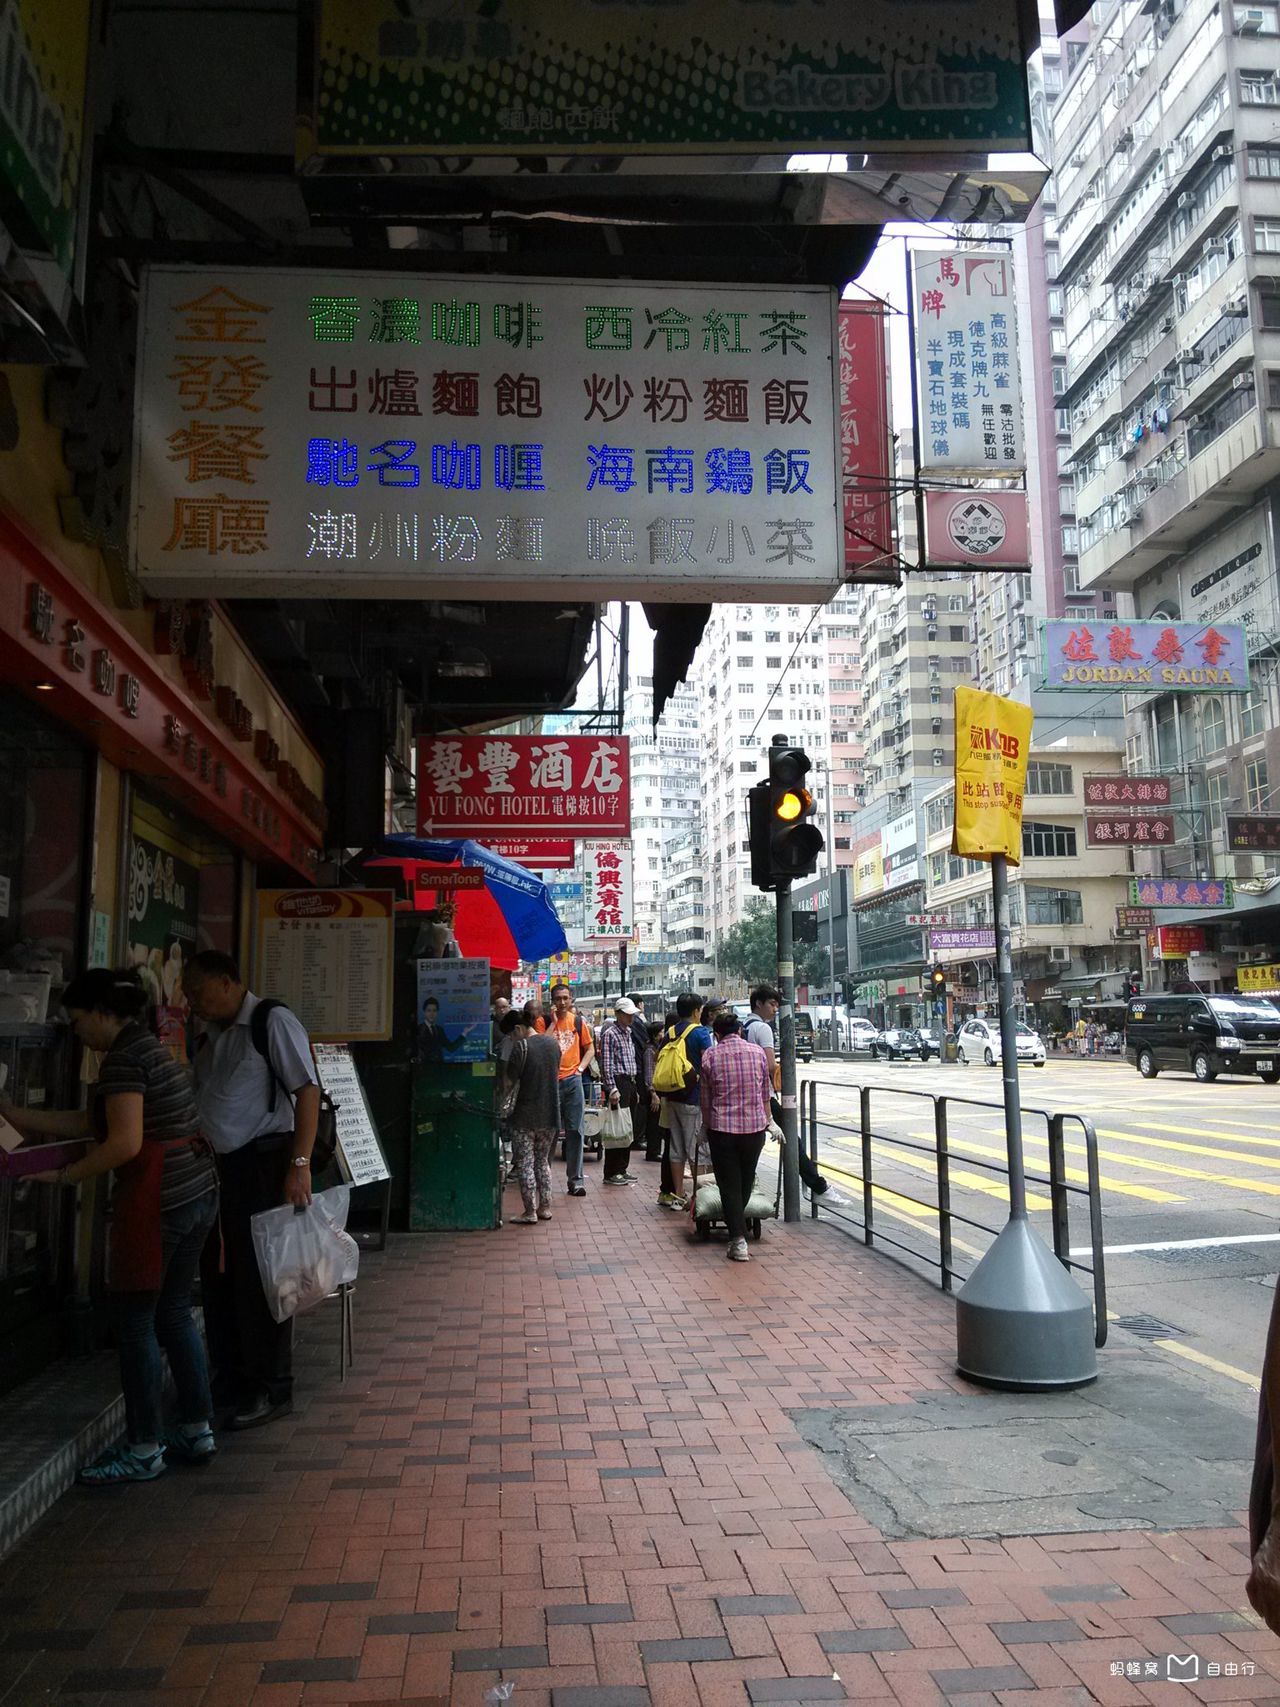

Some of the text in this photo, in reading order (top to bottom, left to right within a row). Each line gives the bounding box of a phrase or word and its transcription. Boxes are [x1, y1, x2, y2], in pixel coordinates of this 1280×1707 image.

[744, 68, 995, 107] Bakery King
[307, 296, 808, 356] 香濃咖啡 西冷紅茶
[307, 366, 812, 425] 出爐麵飽 炒粉麵飯
[926, 339, 950, 457] 半寶石地球儀
[947, 330, 971, 430] 現成套裝碼
[161, 284, 275, 557] 金發餐廳
[306, 437, 545, 491] 馳名咖喱
[306, 510, 816, 565] 潮州粉麵 晚飯小菜
[1062, 625, 1230, 665] 佐敦桑拿
[1062, 666, 1233, 685] JORDAN SAUNA
[424, 741, 624, 794] 藝豐酒店
[429, 795, 620, 816] YU FONG HOTEL 電梯按10字
[596, 842, 611, 851] HING
[612, 842, 631, 851] HOTEL
[421, 872, 481, 886] SmarTone
